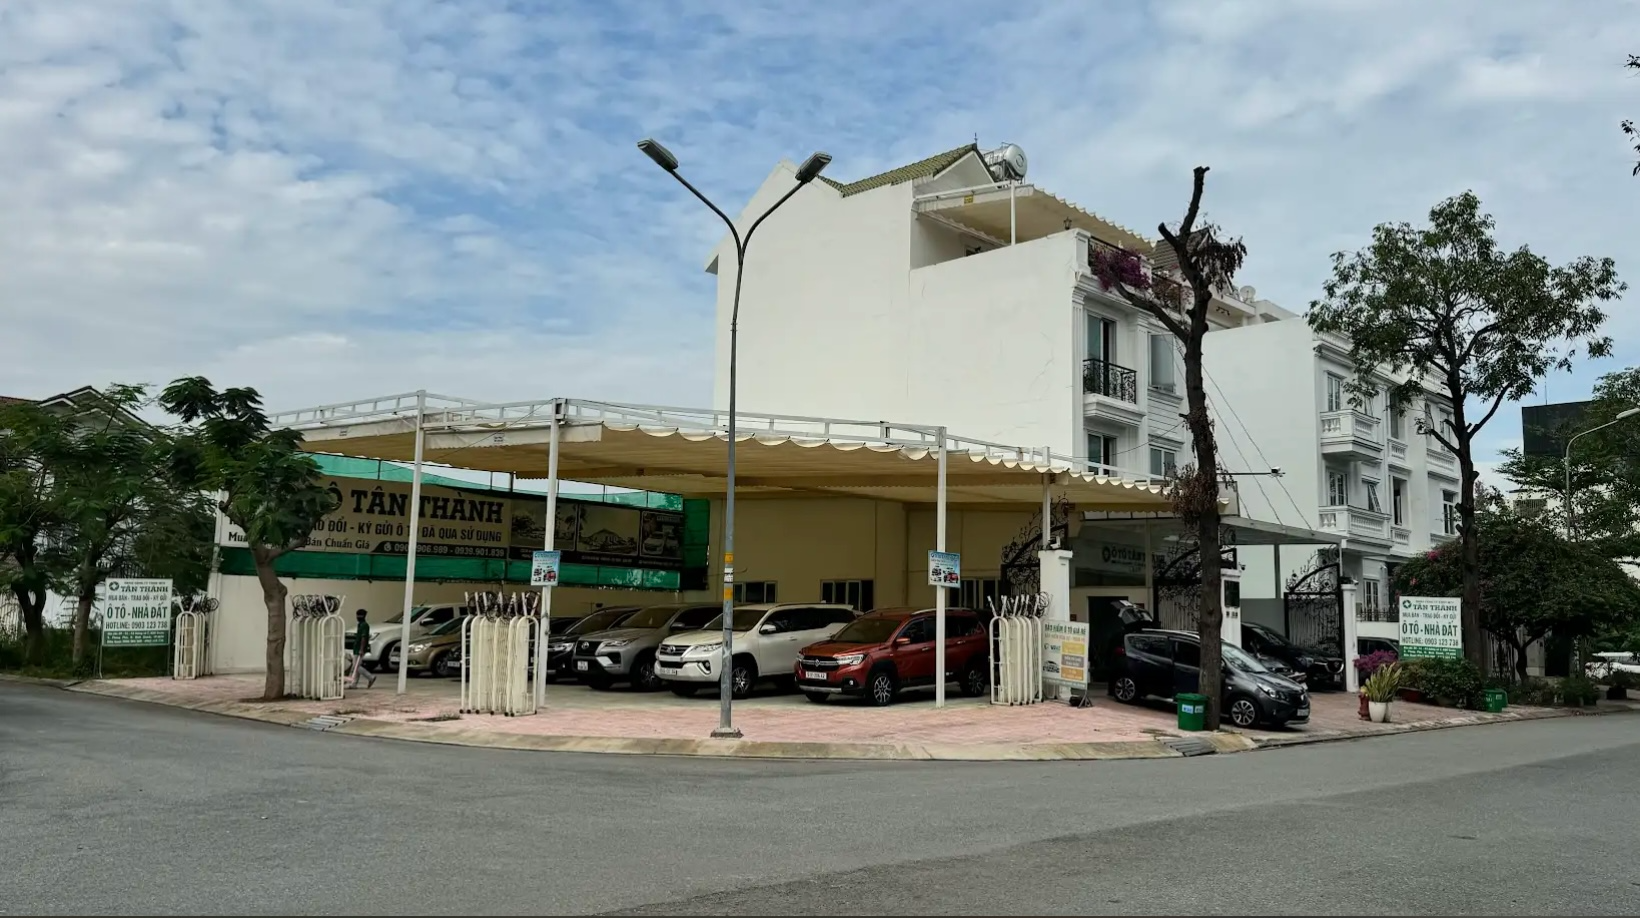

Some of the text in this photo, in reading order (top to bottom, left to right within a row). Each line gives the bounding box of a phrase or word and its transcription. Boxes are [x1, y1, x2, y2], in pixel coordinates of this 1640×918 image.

[350, 485, 409, 517] TÂN
[418, 491, 504, 524] THÀNH
[327, 516, 347, 533] ĐỔI
[357, 521, 372, 534] KÝ
[375, 520, 393, 536] GỬI
[396, 522, 403, 537] Ô
[421, 525, 435, 538] ĐÃ
[438, 527, 457, 540] QUA
[460, 526, 475, 541] SỬ
[476, 531, 502, 544] DỤNG
[355, 540, 370, 550] Giá
[394, 543, 448, 555] 090906.989
[107, 603, 113, 618] Ô
[115, 603, 126, 618] TÔ
[132, 603, 148, 618] NHÀ
[151, 602, 168, 618] ĐẤT
[1402, 620, 1407, 634] Ô
[1409, 620, 1419, 634] TÔ
[1424, 621, 1440, 636] NHÀ
[1442, 620, 1458, 636] ĐẤT
